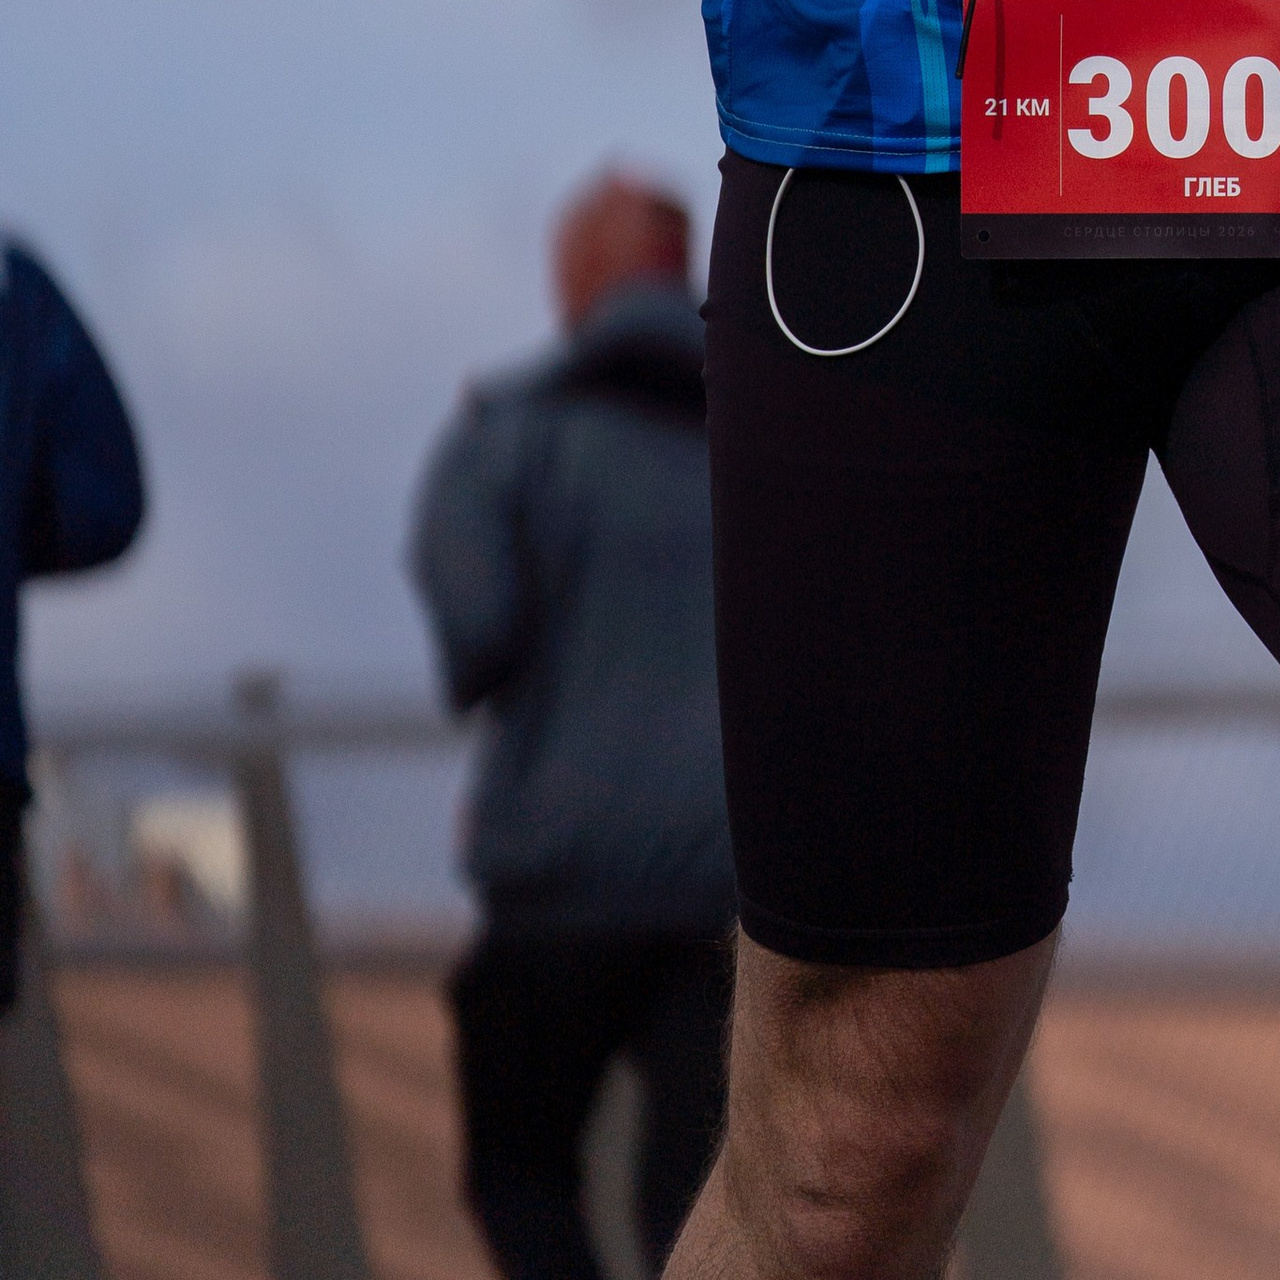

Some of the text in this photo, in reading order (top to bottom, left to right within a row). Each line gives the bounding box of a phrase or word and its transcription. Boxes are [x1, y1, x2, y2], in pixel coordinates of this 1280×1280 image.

[984, 97, 1050, 117] 21 КМ
[1184, 177, 1241, 198] ГЛЕБ
[1063, 226, 1126, 239] СЕРДЦЕ
[1133, 226, 1211, 239] СТОЛИЦЫ
[1218, 225, 1256, 238] 2026
